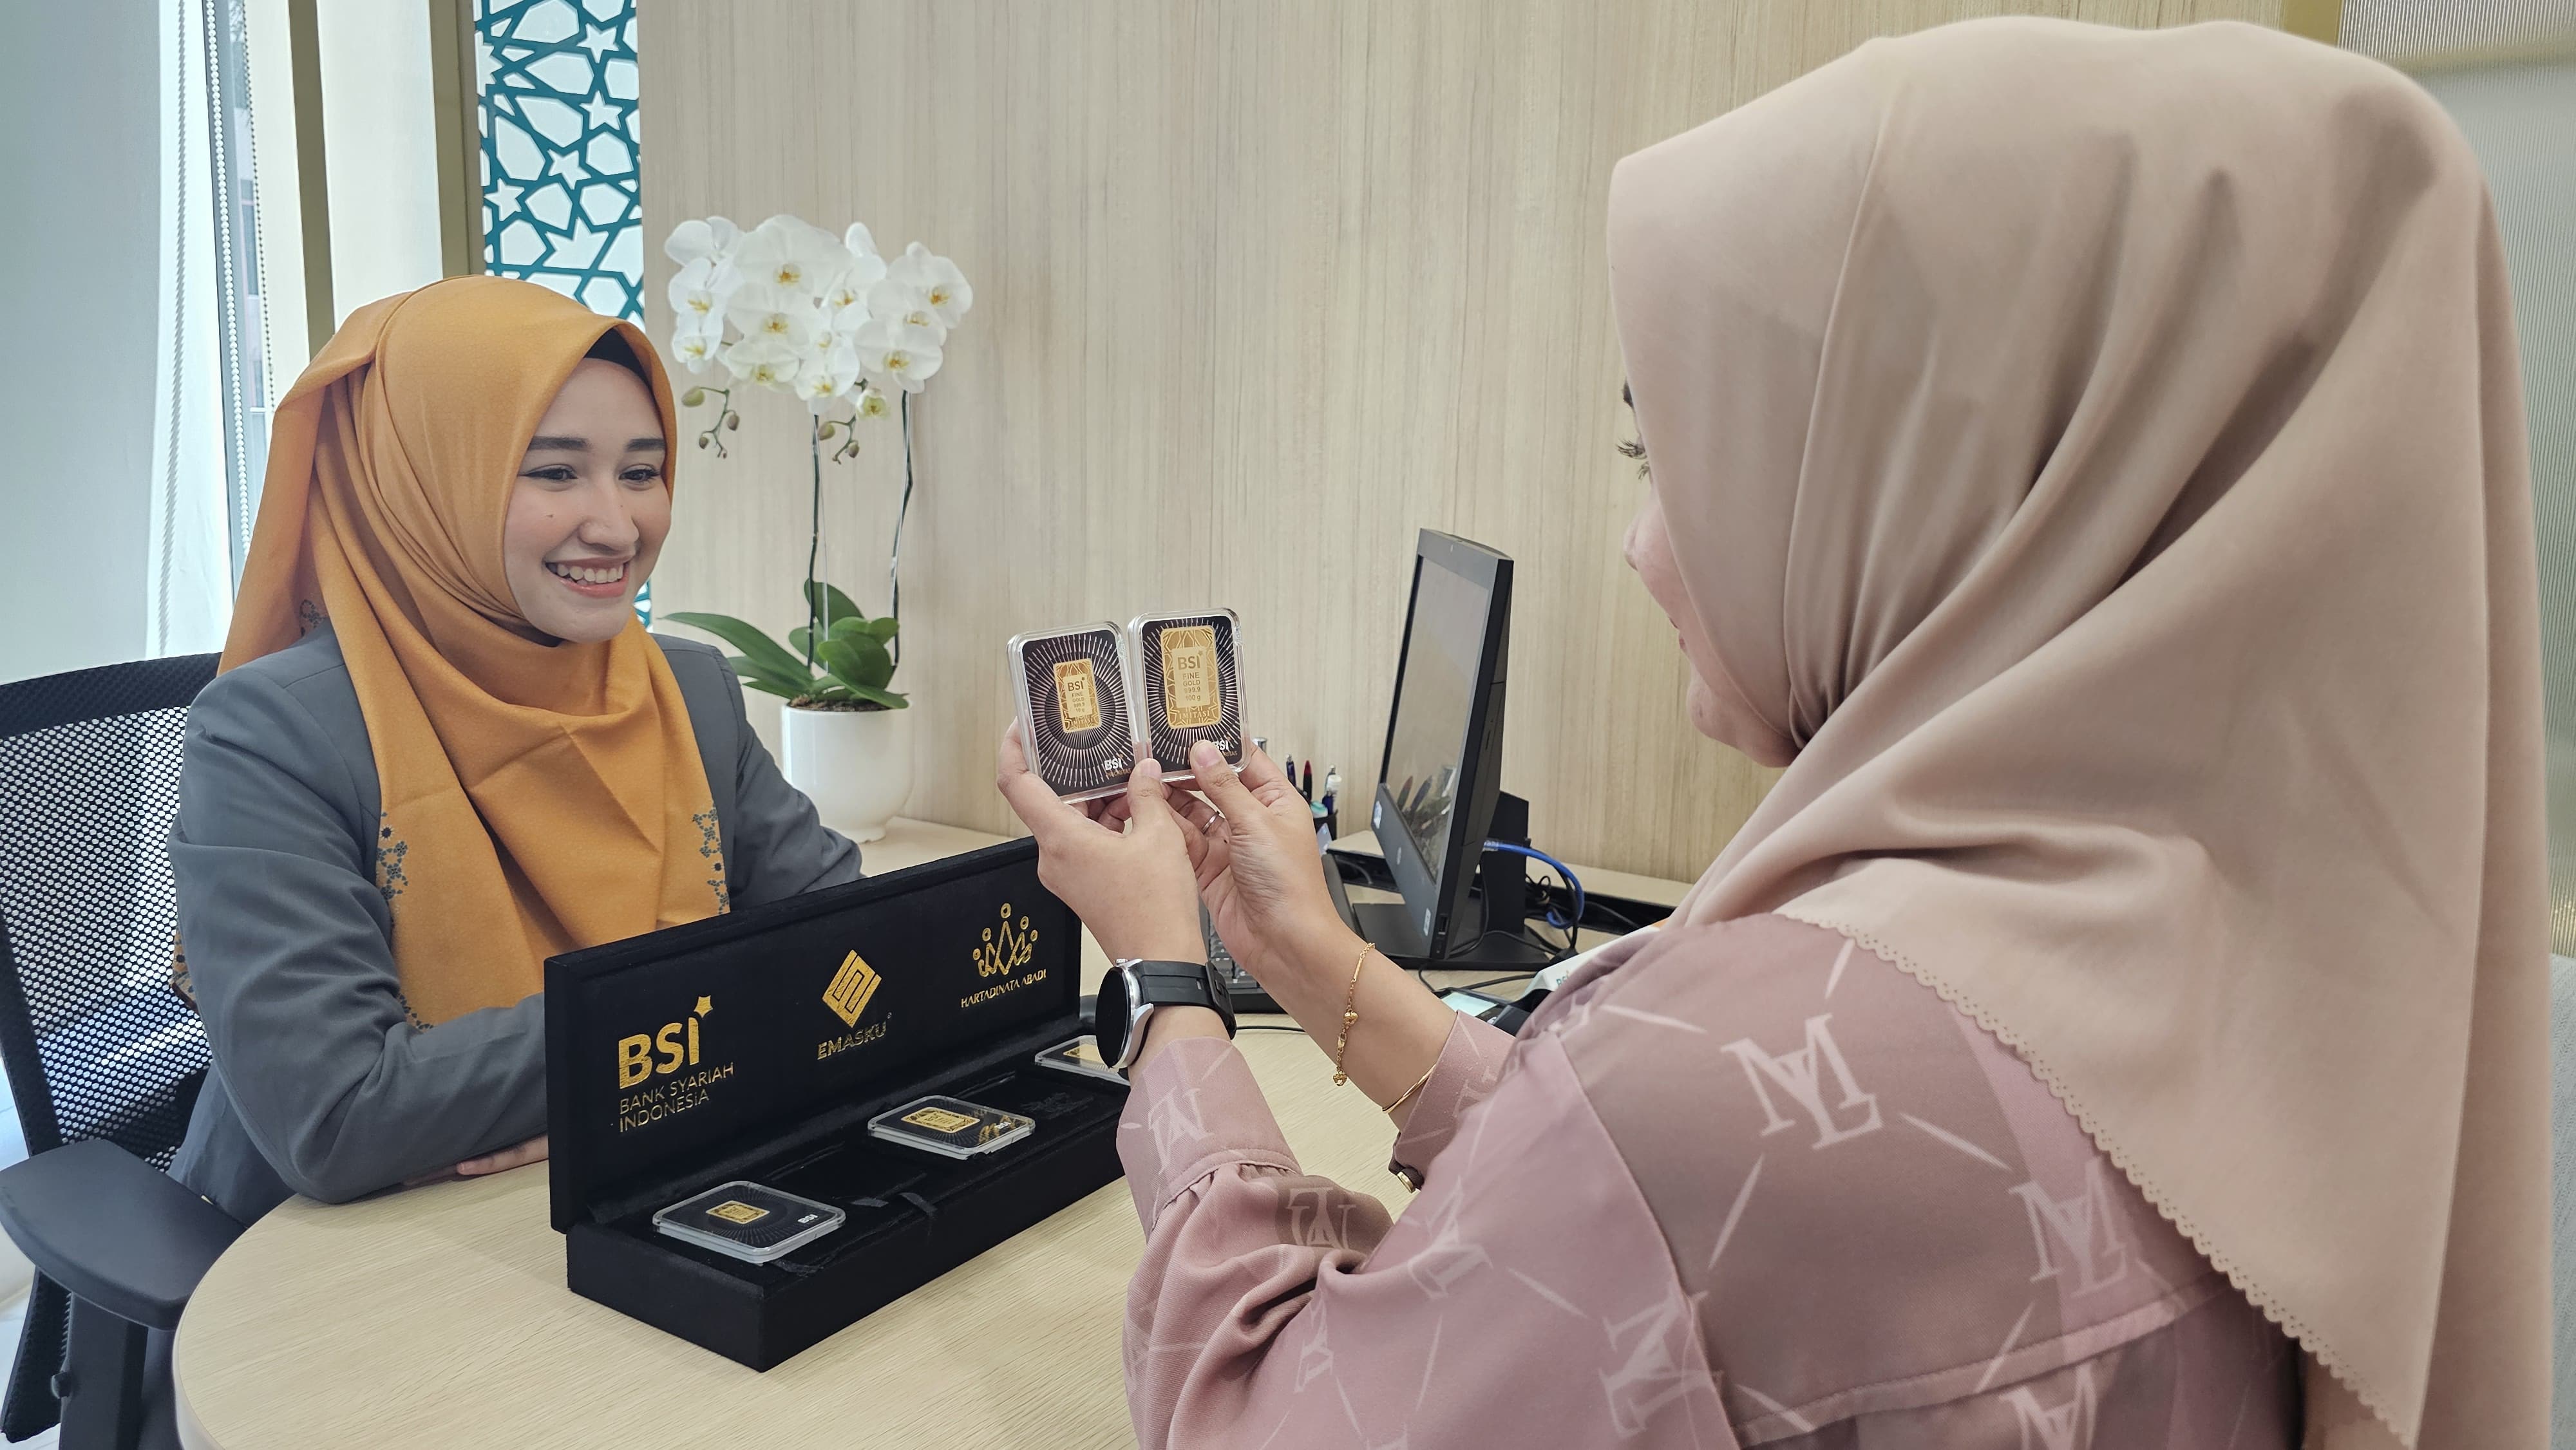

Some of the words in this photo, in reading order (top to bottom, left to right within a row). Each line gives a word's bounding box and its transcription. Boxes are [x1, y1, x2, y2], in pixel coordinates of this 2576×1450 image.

[1178, 655, 1201, 670] BSI
[1068, 680, 1084, 691] BSI
[1179, 710, 1209, 720] IMITASI
[1104, 757, 1122, 771] BSI
[961, 979, 1021, 1008] HARTADINATA
[1022, 969, 1047, 985] ABADI
[619, 1017, 699, 1089] BSI
[620, 1086, 665, 1115] BANK
[670, 1062, 734, 1097] SYARIAH
